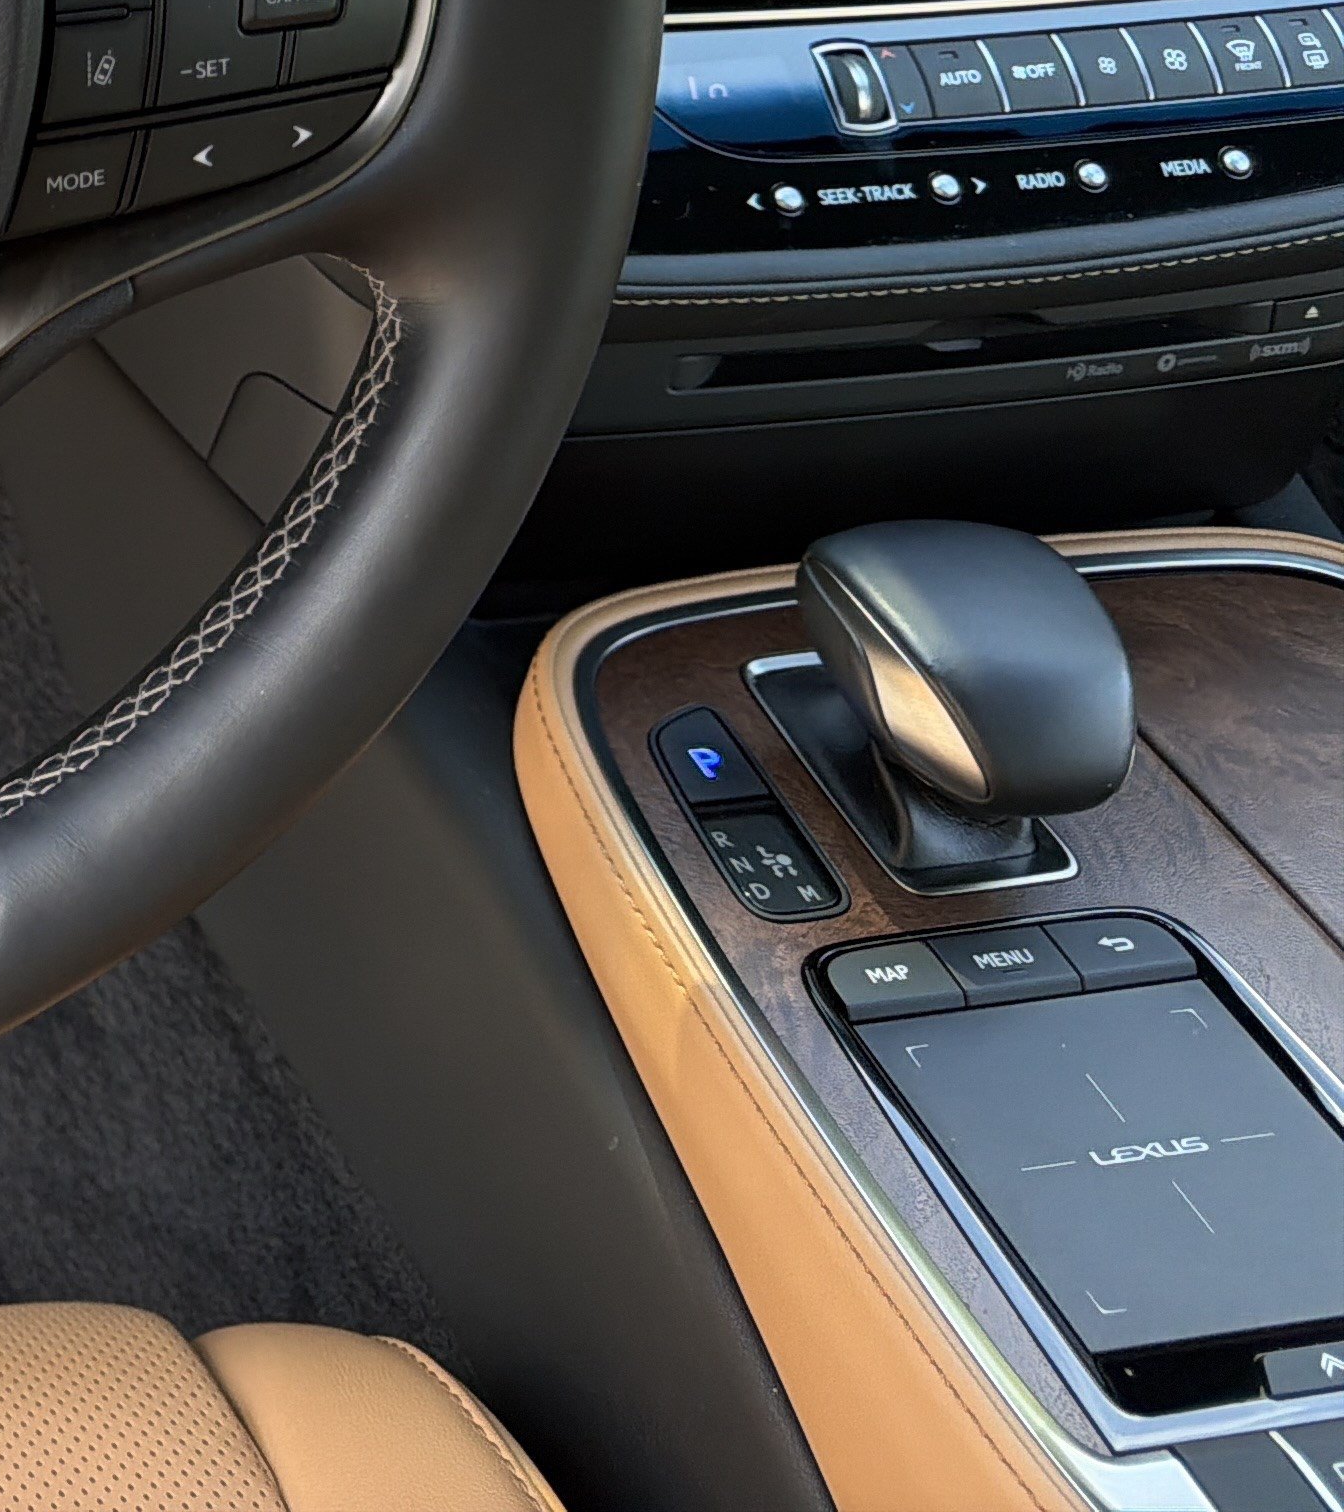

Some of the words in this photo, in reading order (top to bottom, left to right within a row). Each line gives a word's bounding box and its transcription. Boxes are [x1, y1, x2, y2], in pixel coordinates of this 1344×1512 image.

[939, 69, 982, 88] AUTO
[1027, 61, 1057, 80] OFF
[1159, 157, 1213, 178] MEDIA
[45, 169, 107, 195] MODE
[1014, 171, 1067, 190] RADIO
[686, 746, 723, 781] P
[710, 830, 735, 848] R
[728, 856, 755, 874] N
[748, 882, 771, 900] D
[796, 884, 823, 903] M
[971, 947, 1035, 970] MENU
[863, 961, 910, 985] MAP
[1089, 1134, 1210, 1168] LEXUS
